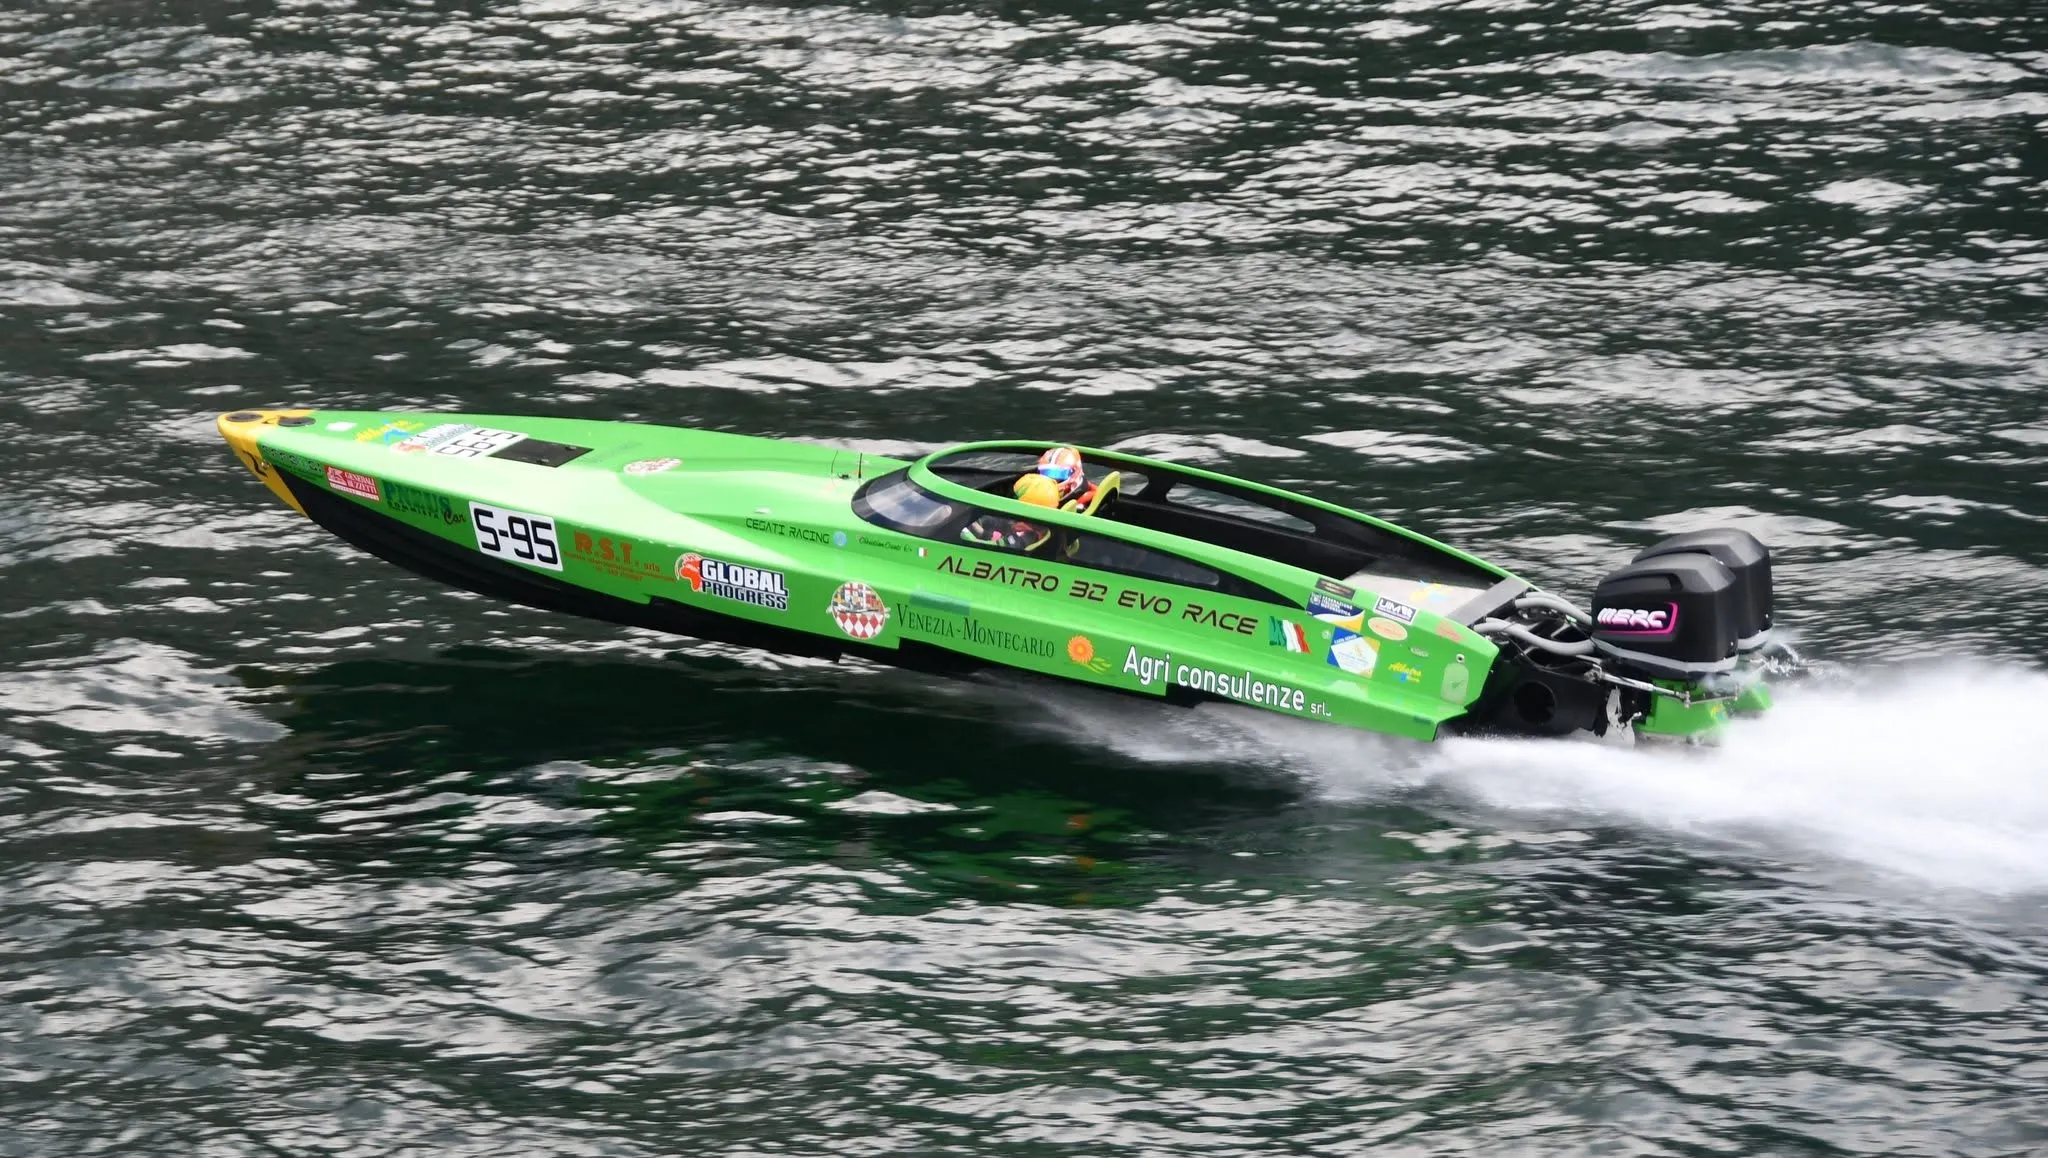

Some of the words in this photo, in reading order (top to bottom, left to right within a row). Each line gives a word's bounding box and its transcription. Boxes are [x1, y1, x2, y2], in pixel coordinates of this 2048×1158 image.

[473, 507, 559, 565] S-95
[745, 517, 785, 536] CESATI
[789, 526, 830, 544] RACING
[700, 558, 788, 596] GLOBAL
[701, 580, 788, 611] PROGRESS
[936, 555, 1060, 593] ALBATRO
[1117, 589, 1173, 616] EVO
[1181, 603, 1259, 636] RACE
[1597, 607, 1667, 629] MERC
[1122, 645, 1170, 686] Agri
[1176, 663, 1305, 712] consulenze
